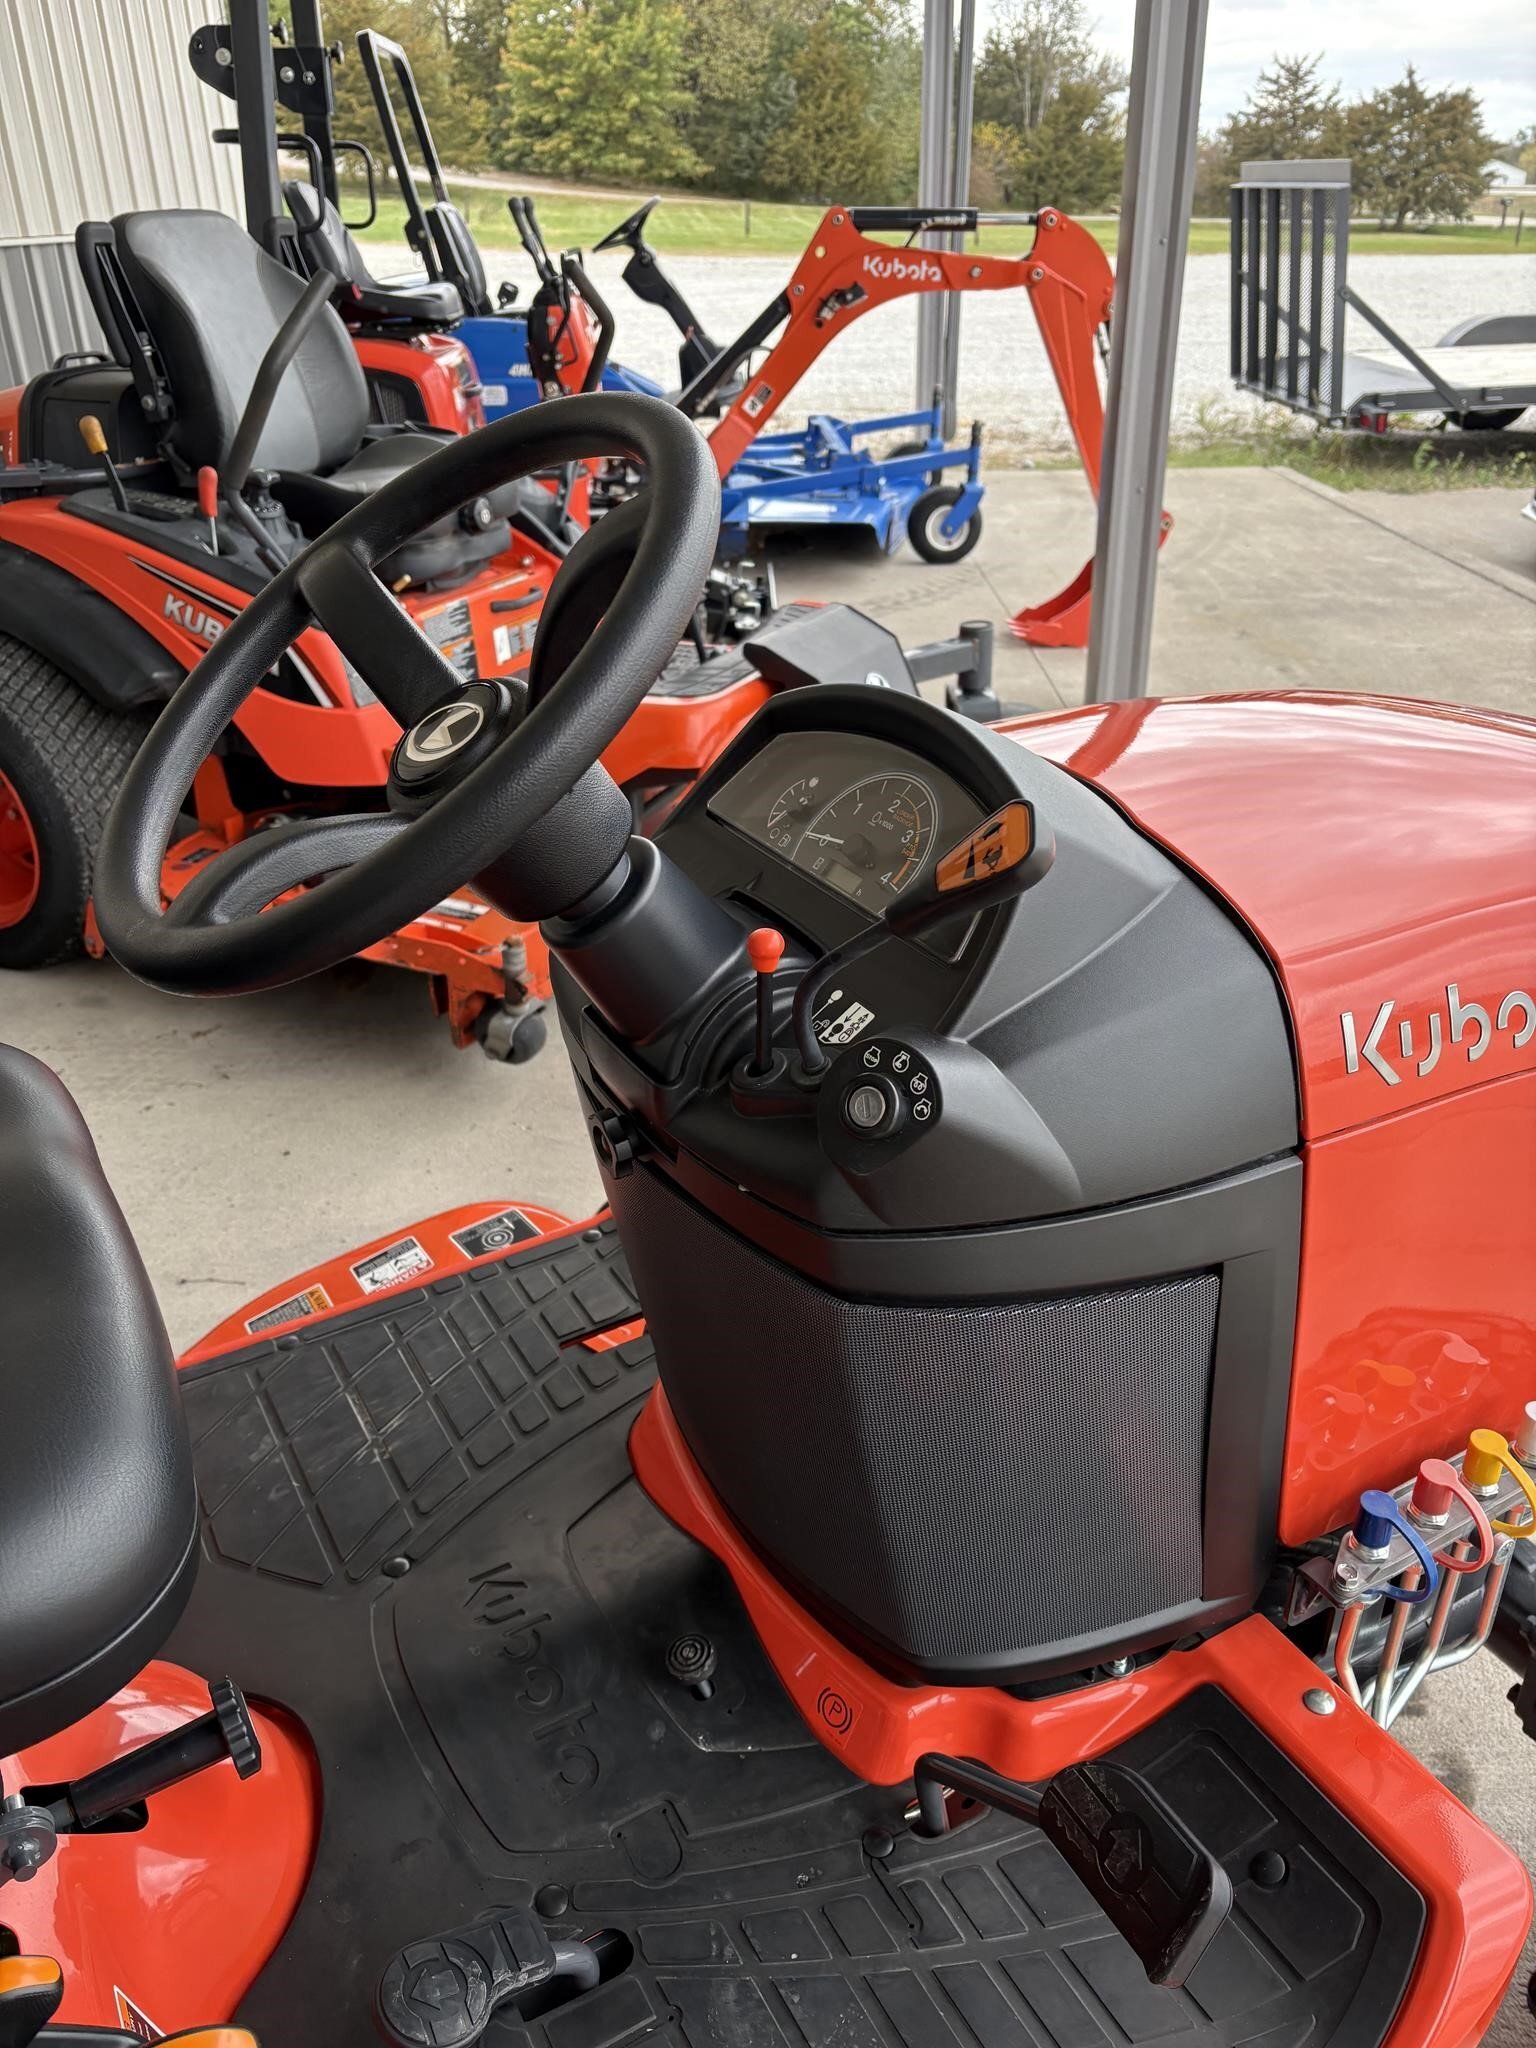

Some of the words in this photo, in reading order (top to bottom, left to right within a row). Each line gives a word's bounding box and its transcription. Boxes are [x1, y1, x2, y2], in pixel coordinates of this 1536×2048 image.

[863, 255, 943, 282] Kubota
[853, 802, 863, 815] 1
[888, 799, 901, 813] 2
[901, 829, 914, 843] 3
[880, 871, 893, 885] 4
[1340, 983, 1536, 1086] Kubo
[865, 1053, 878, 1063] STOP
[463, 1562, 599, 1803] Kubota
